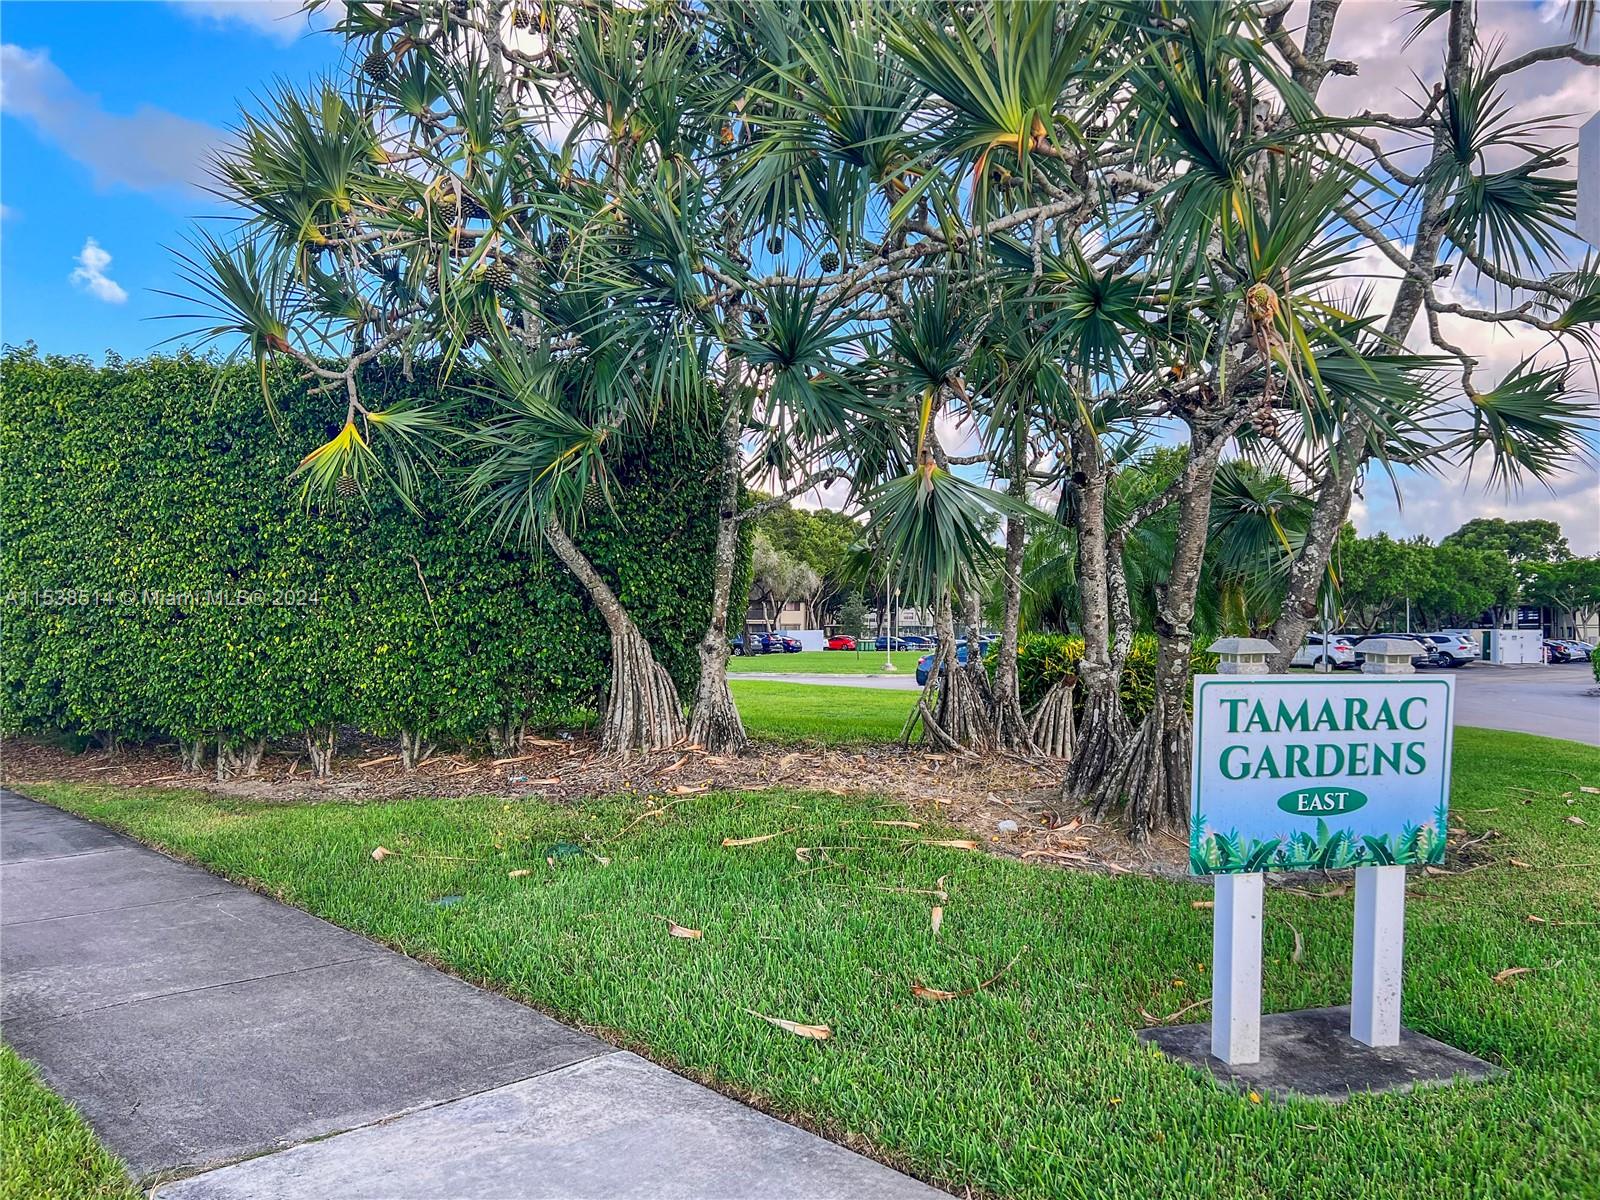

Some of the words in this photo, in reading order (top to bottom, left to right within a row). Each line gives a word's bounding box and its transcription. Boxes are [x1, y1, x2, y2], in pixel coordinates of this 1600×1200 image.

[1219, 697, 1428, 733] TAMARAC
[1218, 741, 1427, 780] GARDENS
[1297, 792, 1349, 812] EAST
